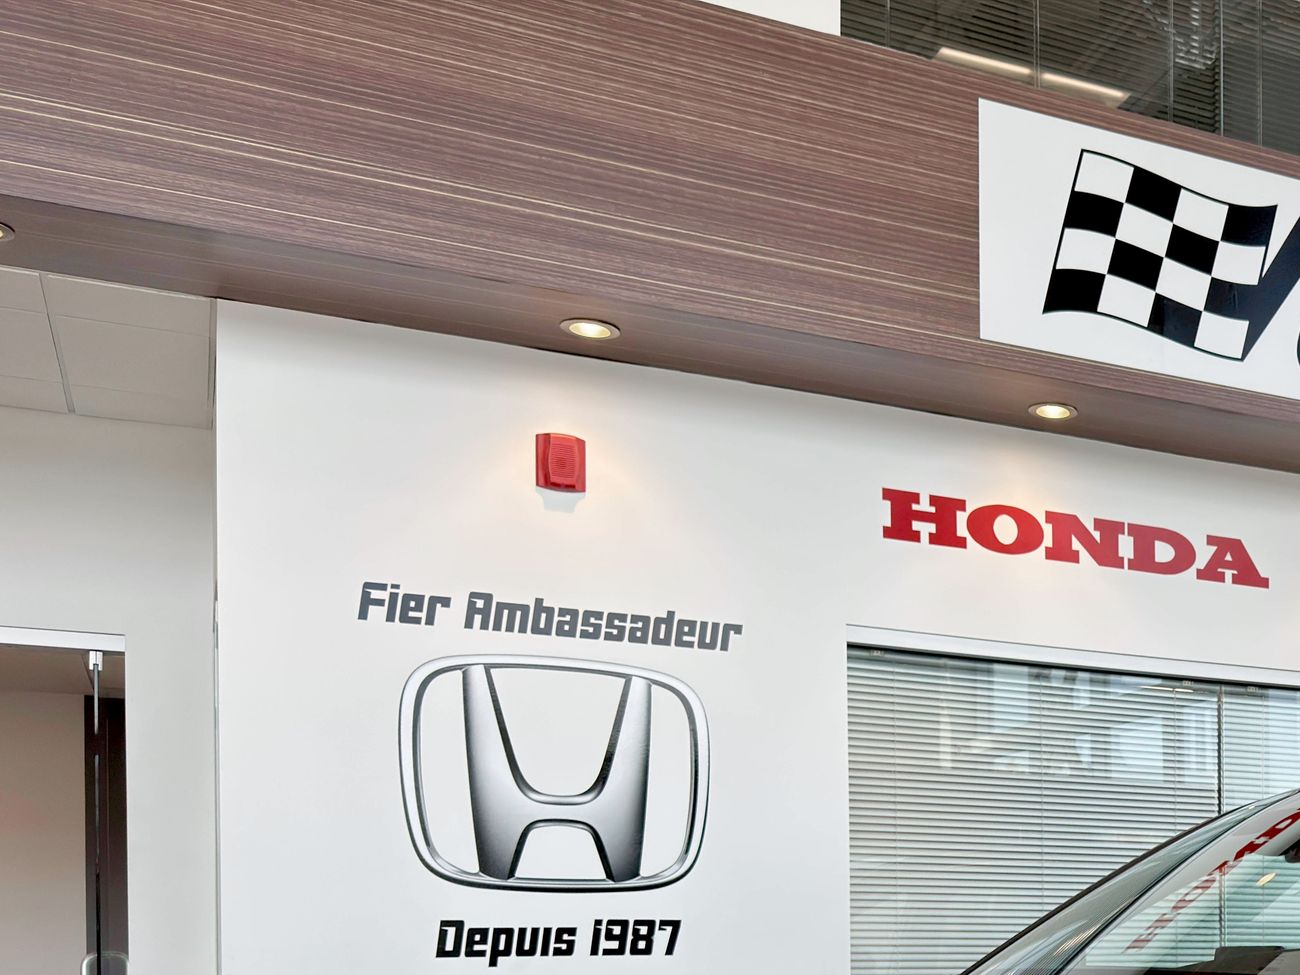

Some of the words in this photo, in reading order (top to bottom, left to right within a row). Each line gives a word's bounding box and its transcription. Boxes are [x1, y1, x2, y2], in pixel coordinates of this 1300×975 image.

[882, 488, 1269, 589] HONDA
[357, 581, 452, 627] Fier
[463, 591, 744, 652] Ambassadeur
[435, 919, 578, 968] Depuis
[589, 918, 682, 957] 1987
